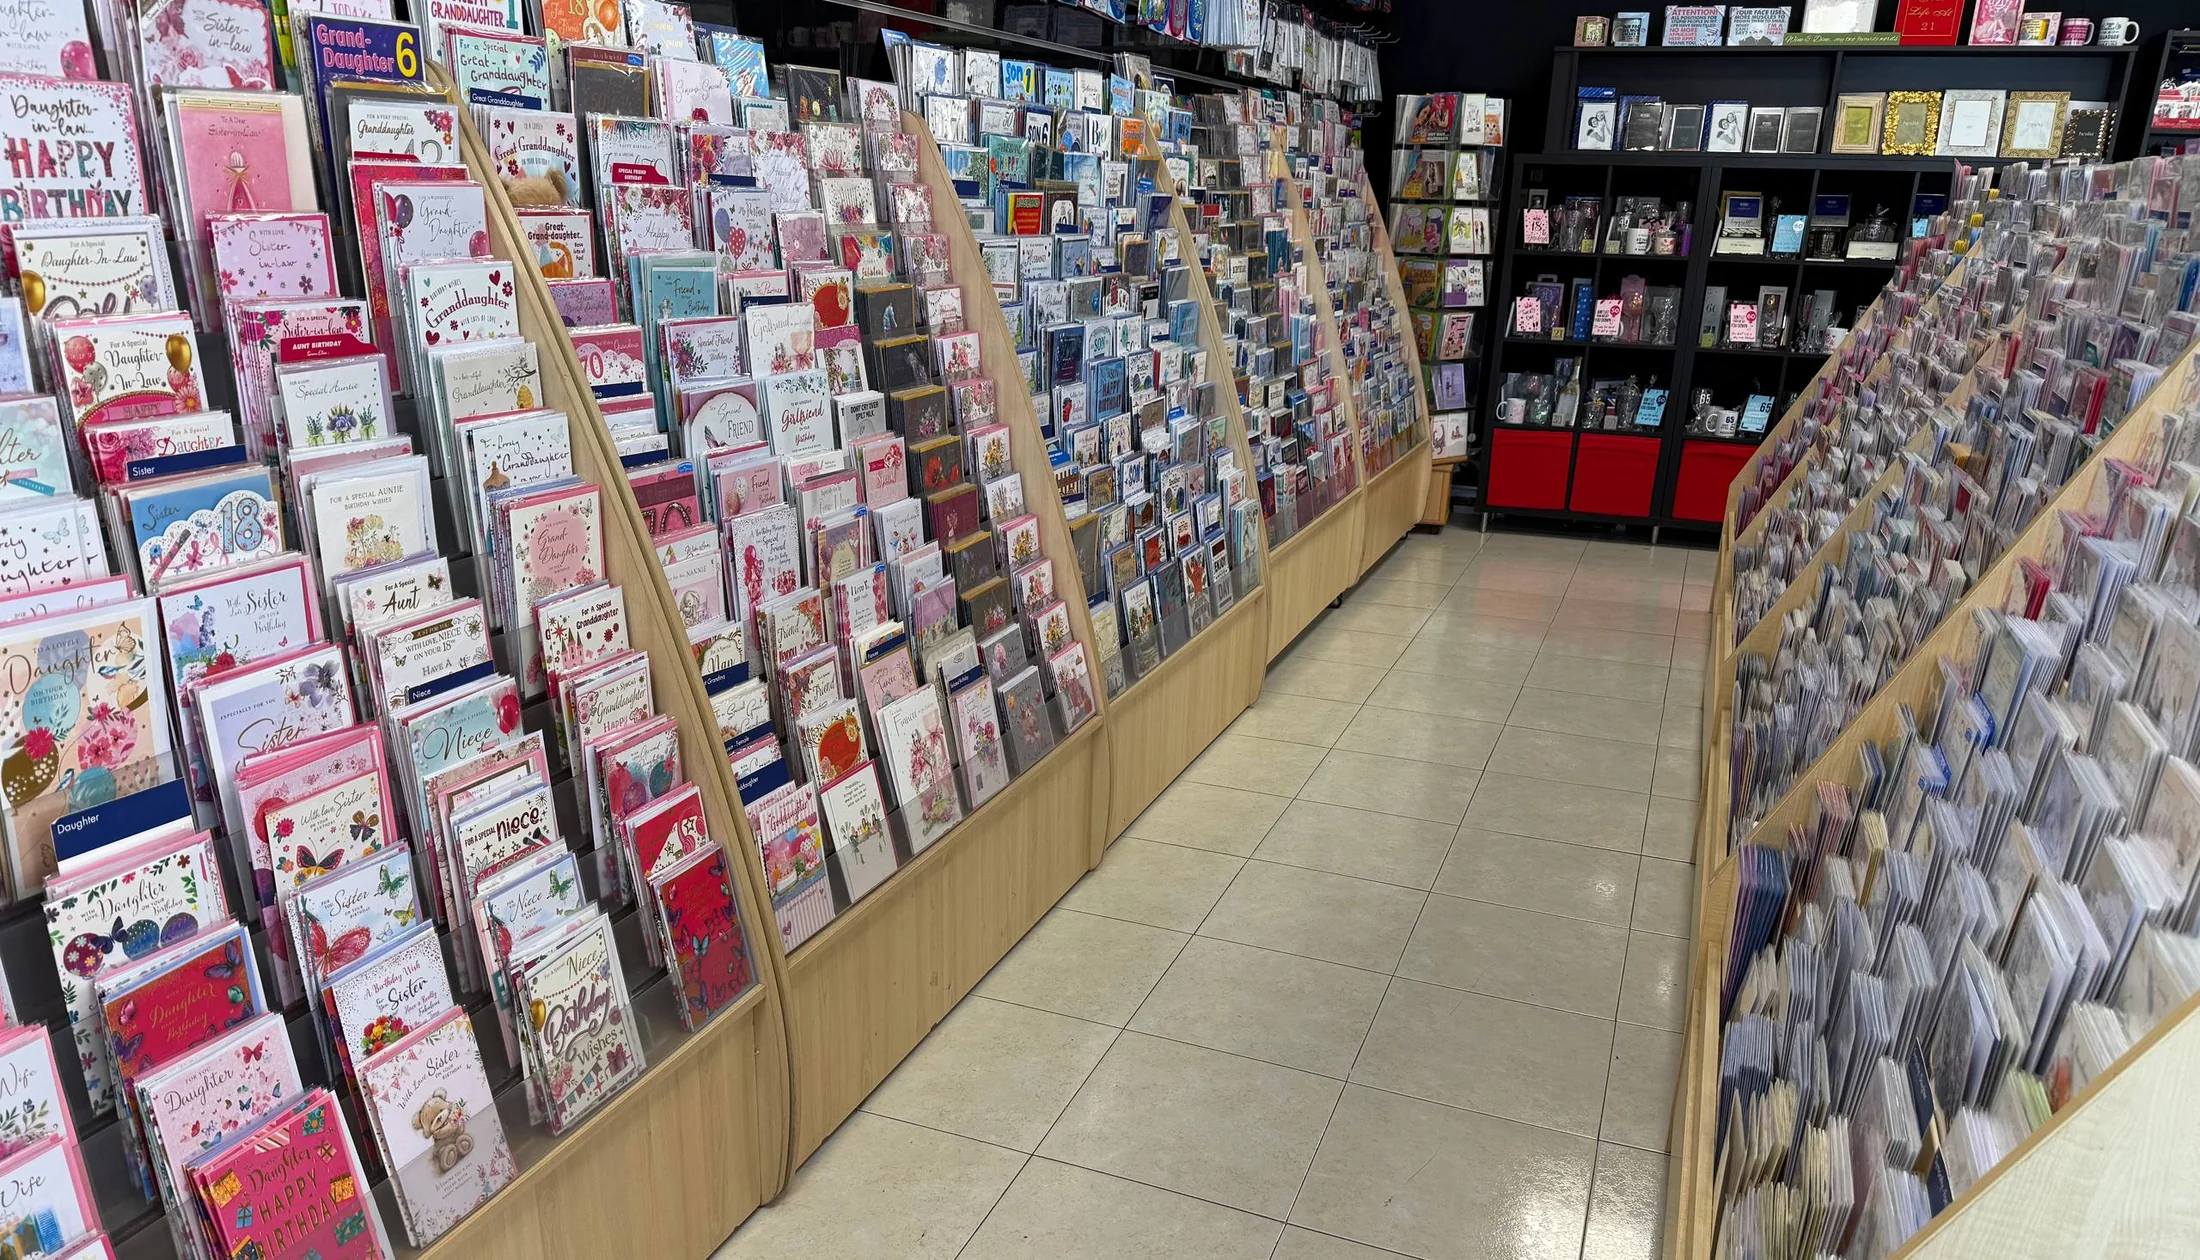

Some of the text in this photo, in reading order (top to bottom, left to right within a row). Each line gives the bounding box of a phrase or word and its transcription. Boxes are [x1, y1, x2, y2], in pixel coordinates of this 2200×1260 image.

[430, 4, 506, 29] GRANDDAUGHTER
[1672, 8, 1720, 16] ATTENTION!
[1908, 8, 1953, 19] Life At
[317, 23, 372, 47] Grand-
[1921, 22, 1935, 31] 21
[208, 36, 253, 53] in-law
[396, 31, 418, 78] 6
[459, 39, 508, 54] For Special
[323, 47, 395, 74] Daughter
[470, 68, 548, 91] Granddaughter
[1024, 69, 1032, 94] 1
[10, 94, 99, 119] Daughter-
[472, 92, 525, 108] Great Granddaughter
[357, 118, 415, 140] Granddaughter
[1028, 125, 1042, 143] SON
[1042, 123, 1049, 144] 6
[5, 137, 116, 178] HAPPY
[494, 135, 576, 162] Great Granddaughter
[0, 186, 132, 221] BIRTHDAY
[545, 222, 566, 233] Great-
[1531, 222, 1542, 231] 18
[70, 240, 79, 248] For
[84, 240, 106, 249] Special
[674, 278, 695, 298] Friend
[425, 286, 510, 329] Granddaughter
[126, 338, 148, 349] Special
[292, 340, 342, 351] AUNT BIRTHDAY
[104, 347, 163, 371] Daughter-
[295, 383, 328, 399] Special
[452, 380, 506, 403] Granddaughter
[718, 402, 742, 423] Special
[782, 400, 825, 432] Girlfriend
[869, 401, 879, 410] OVER
[1759, 402, 1772, 414] 65
[188, 425, 210, 435] Special
[727, 420, 754, 439] FRIEND
[1726, 416, 1734, 424] 65
[132, 465, 156, 479] Sister
[751, 472, 770, 492] Friend
[329, 485, 404, 505] FOR A SPECIAL AUNTIE
[344, 496, 392, 511] BIRTHDAY WISHES
[142, 504, 181, 532] Sister
[219, 496, 263, 555] 18
[384, 582, 393, 591] For
[398, 578, 416, 590] Special
[246, 588, 289, 616] Sister
[382, 585, 422, 615] Aunt
[581, 599, 612, 616] For A Special
[576, 607, 619, 630] Granddaughter
[52, 638, 81, 651] LOVELY
[406, 627, 462, 653] WITH NIECE
[3, 636, 117, 694] Daughter
[413, 646, 442, 661] ON YOUR
[443, 661, 453, 671] A
[30, 691, 68, 707] BIRTHDAY
[33, 685, 63, 698] ON YOUR
[412, 687, 432, 699] Niece
[606, 688, 615, 697] FOR
[813, 674, 835, 701] Friend
[220, 698, 276, 720] ESPECIALLY FOR YOU
[597, 688, 646, 724] Granddaughter
[237, 717, 308, 756] Sister
[422, 725, 493, 761] Niece
[300, 790, 366, 826] With Sister
[56, 813, 100, 836] Daughter
[464, 837, 473, 848] FOR
[478, 827, 496, 842] SPECIAL
[81, 878, 168, 922] WITH Daughter
[150, 898, 164, 908] YOUR
[153, 898, 183, 917] Birthday
[330, 888, 370, 917] Sister
[509, 889, 543, 924] Niece
[566, 949, 599, 981] Niece
[373, 960, 422, 994] Birthday Wish
[150, 981, 219, 1028] Daughter
[388, 977, 428, 1010] Sister
[404, 992, 437, 1014] Have Really
[543, 983, 611, 1056] Birthday
[575, 1029, 618, 1068] Wishes
[397, 1049, 461, 1110] With Sister
[164, 1068, 234, 1115] Daughter
[248, 1146, 312, 1196] Daughter
[258, 1168, 318, 1224] HAPPY
[255, 1186, 340, 1260] BIRTHDAY
